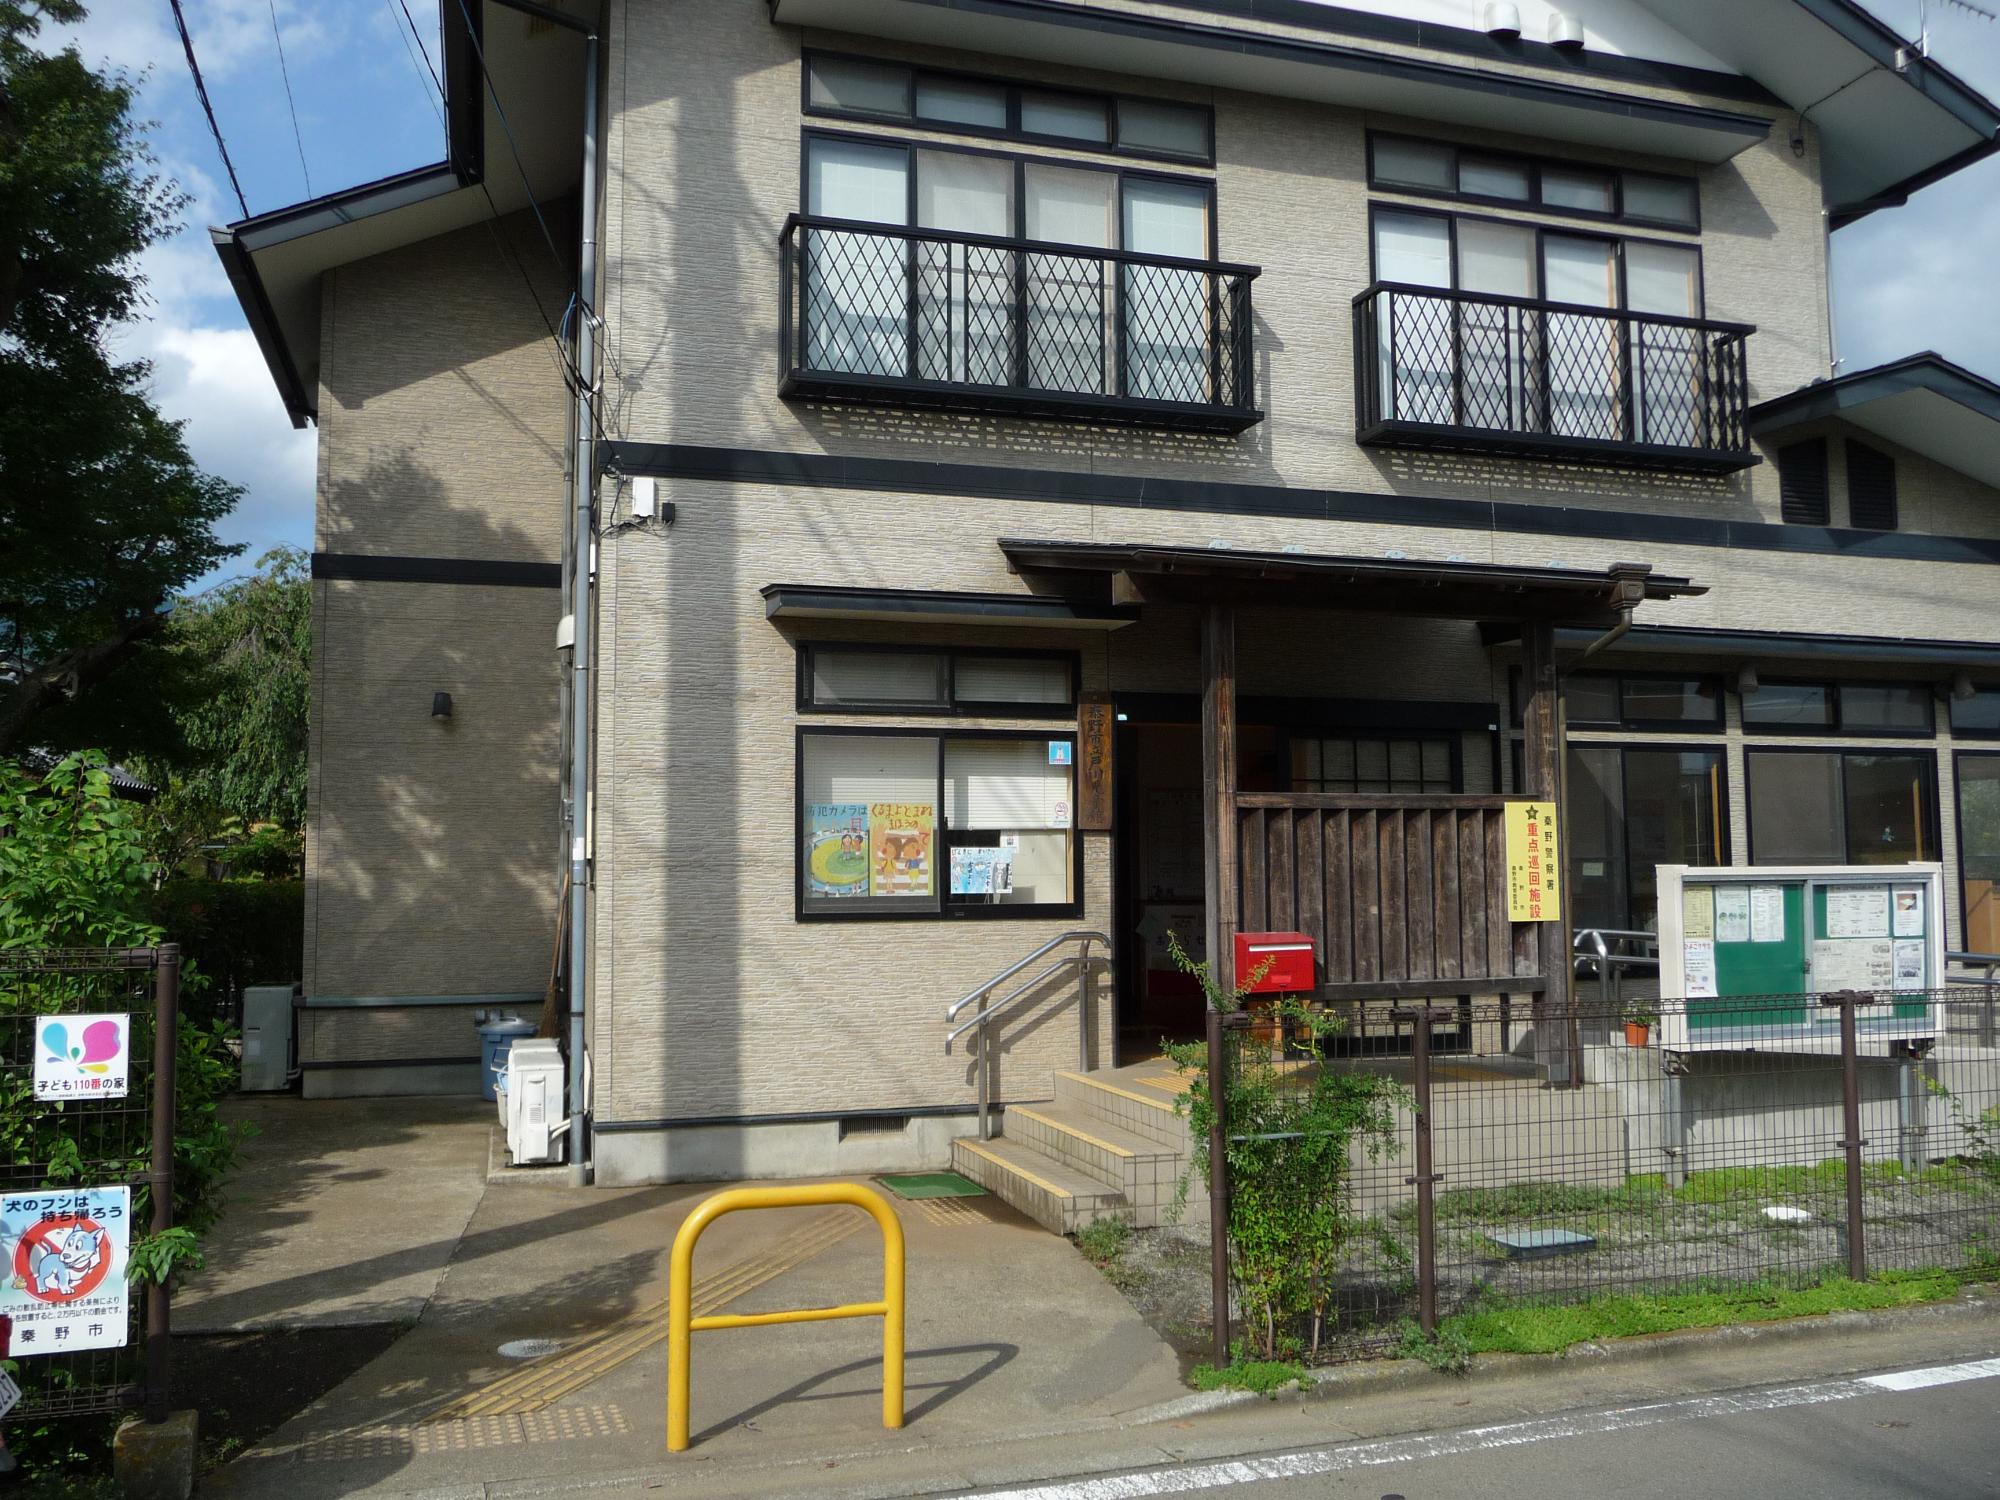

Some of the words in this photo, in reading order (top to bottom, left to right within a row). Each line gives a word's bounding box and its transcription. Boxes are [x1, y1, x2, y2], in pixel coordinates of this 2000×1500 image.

[1544, 815, 1555, 891] 秦野警察署
[1527, 822, 1542, 920] 重点巡回施設
[37, 1077, 125, 1092] 子ども110番の家
[5, 1195, 89, 1213] 犬のフンは
[40, 1206, 123, 1223] 持ち帰ろう
[20, 1322, 104, 1343] 秦野市
